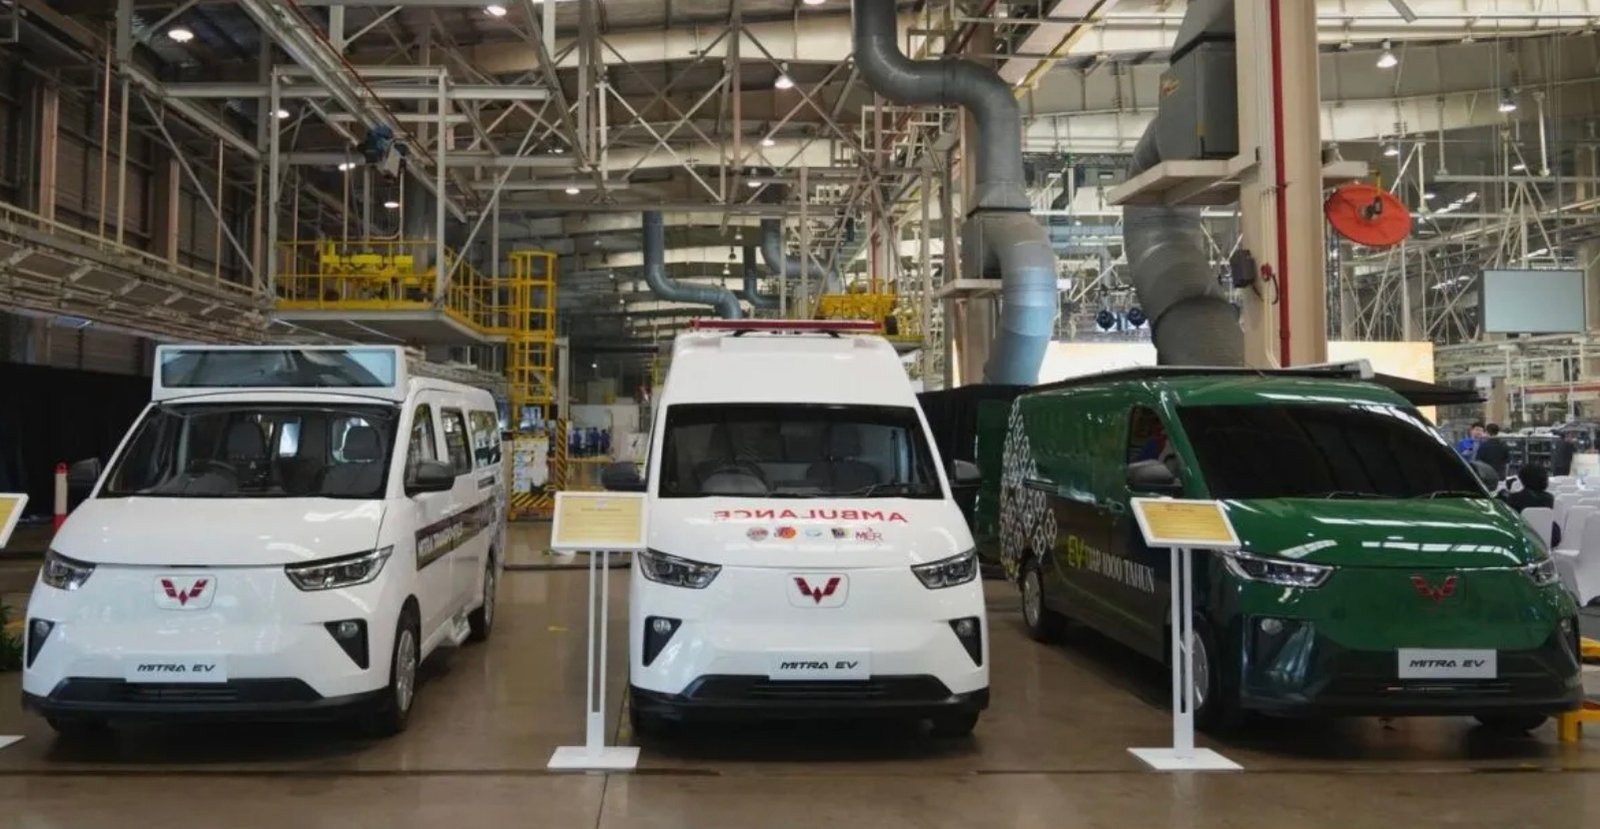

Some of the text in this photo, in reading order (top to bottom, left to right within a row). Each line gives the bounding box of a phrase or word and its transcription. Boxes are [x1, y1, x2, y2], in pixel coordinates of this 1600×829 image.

[1067, 534, 1086, 570] EV
[1123, 559, 1155, 593] TAHUN
[780, 661, 858, 669] MITRA EV
[1409, 659, 1485, 668] MITRA EV
[137, 664, 216, 672] MITRA EV
